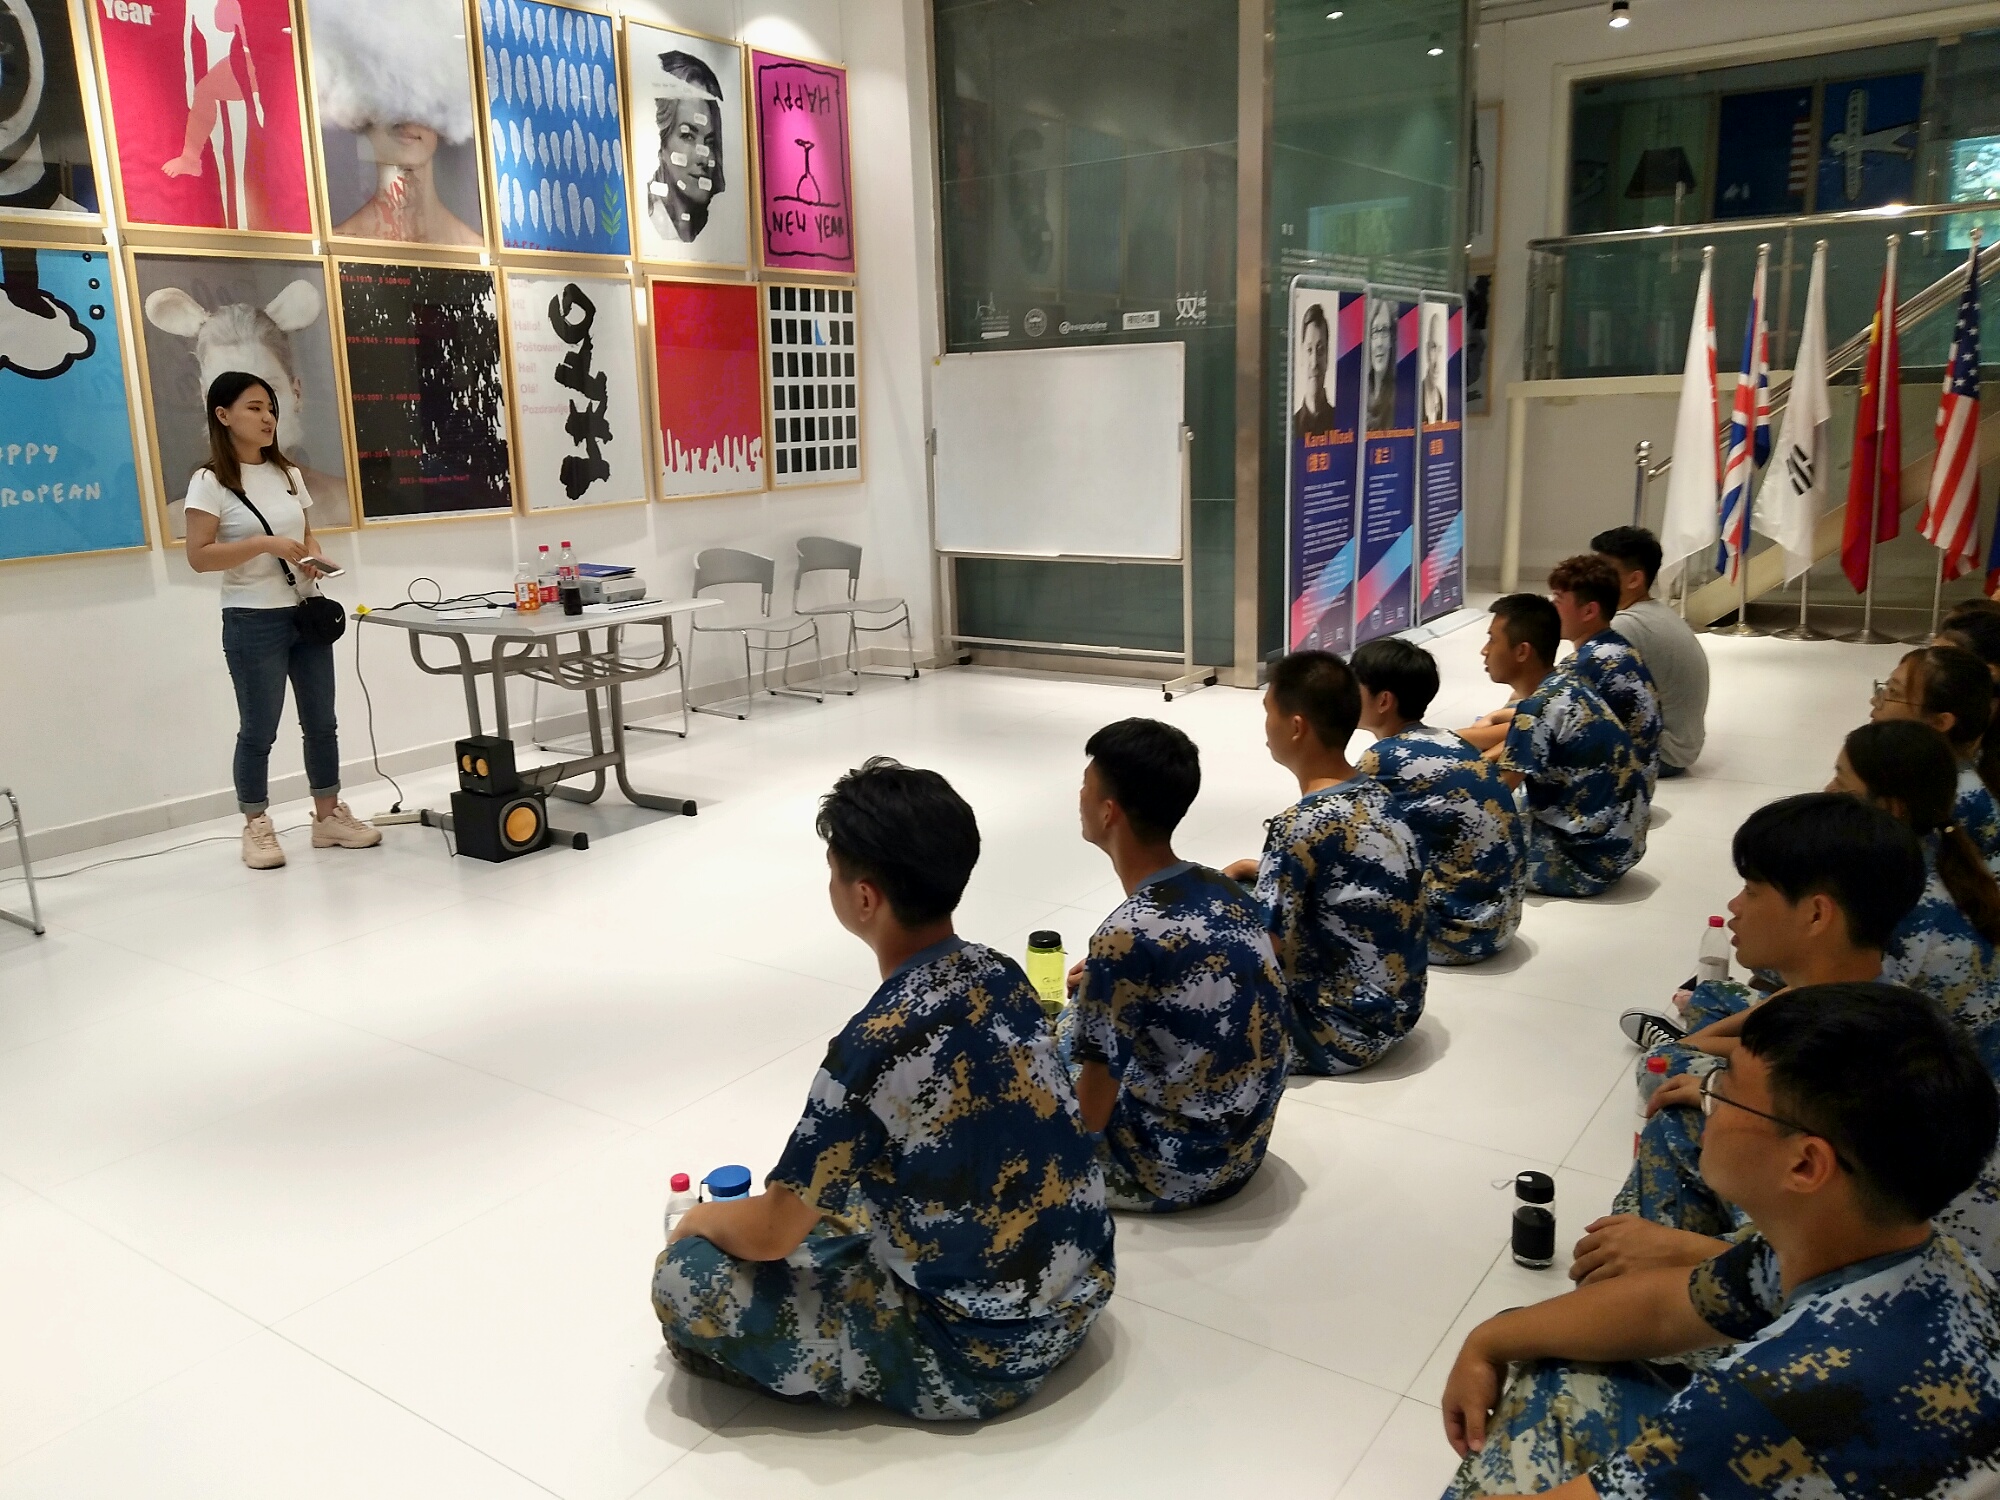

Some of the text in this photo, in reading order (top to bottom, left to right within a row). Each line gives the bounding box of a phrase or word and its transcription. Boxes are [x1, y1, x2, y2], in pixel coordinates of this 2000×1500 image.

[102, 0, 154, 26] Year
[773, 81, 830, 114] HAPPY
[772, 210, 844, 243] NEW YEAR
[1, 482, 101, 508] ROPEAN
